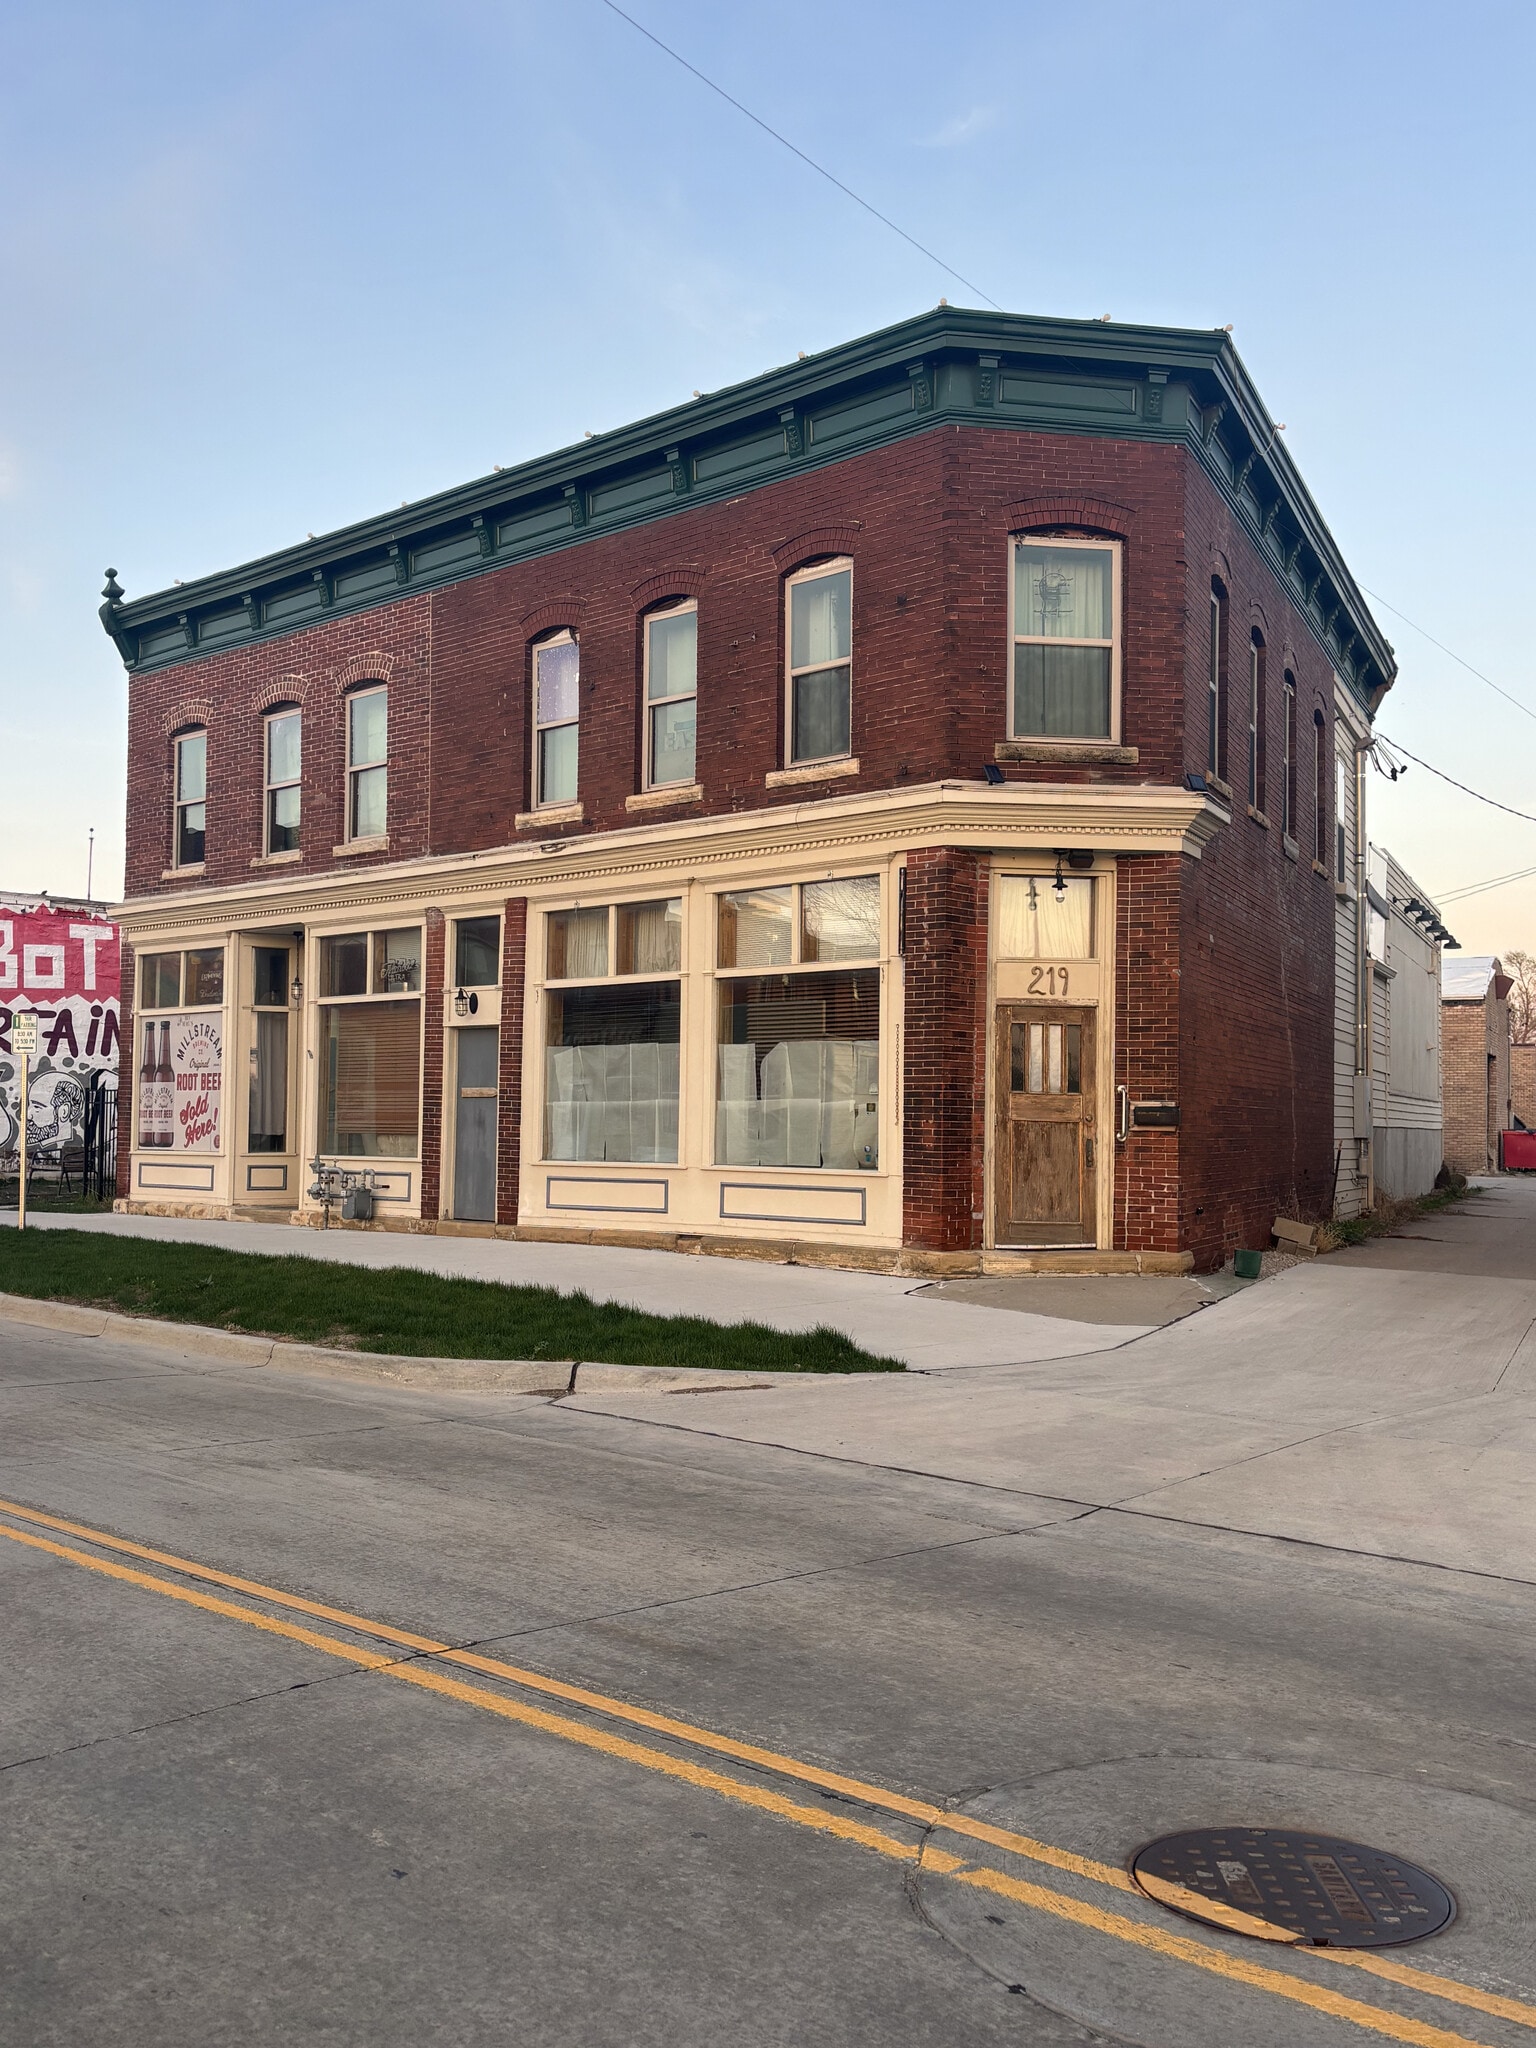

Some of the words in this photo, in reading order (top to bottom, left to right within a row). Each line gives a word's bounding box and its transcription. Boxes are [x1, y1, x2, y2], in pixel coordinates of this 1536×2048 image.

[1027, 966, 1068, 996] 219
[177, 1023, 222, 1060] MILLSTREAM
[177, 1073, 198, 1091] ROOT
[180, 1092, 209, 1125] Sold
